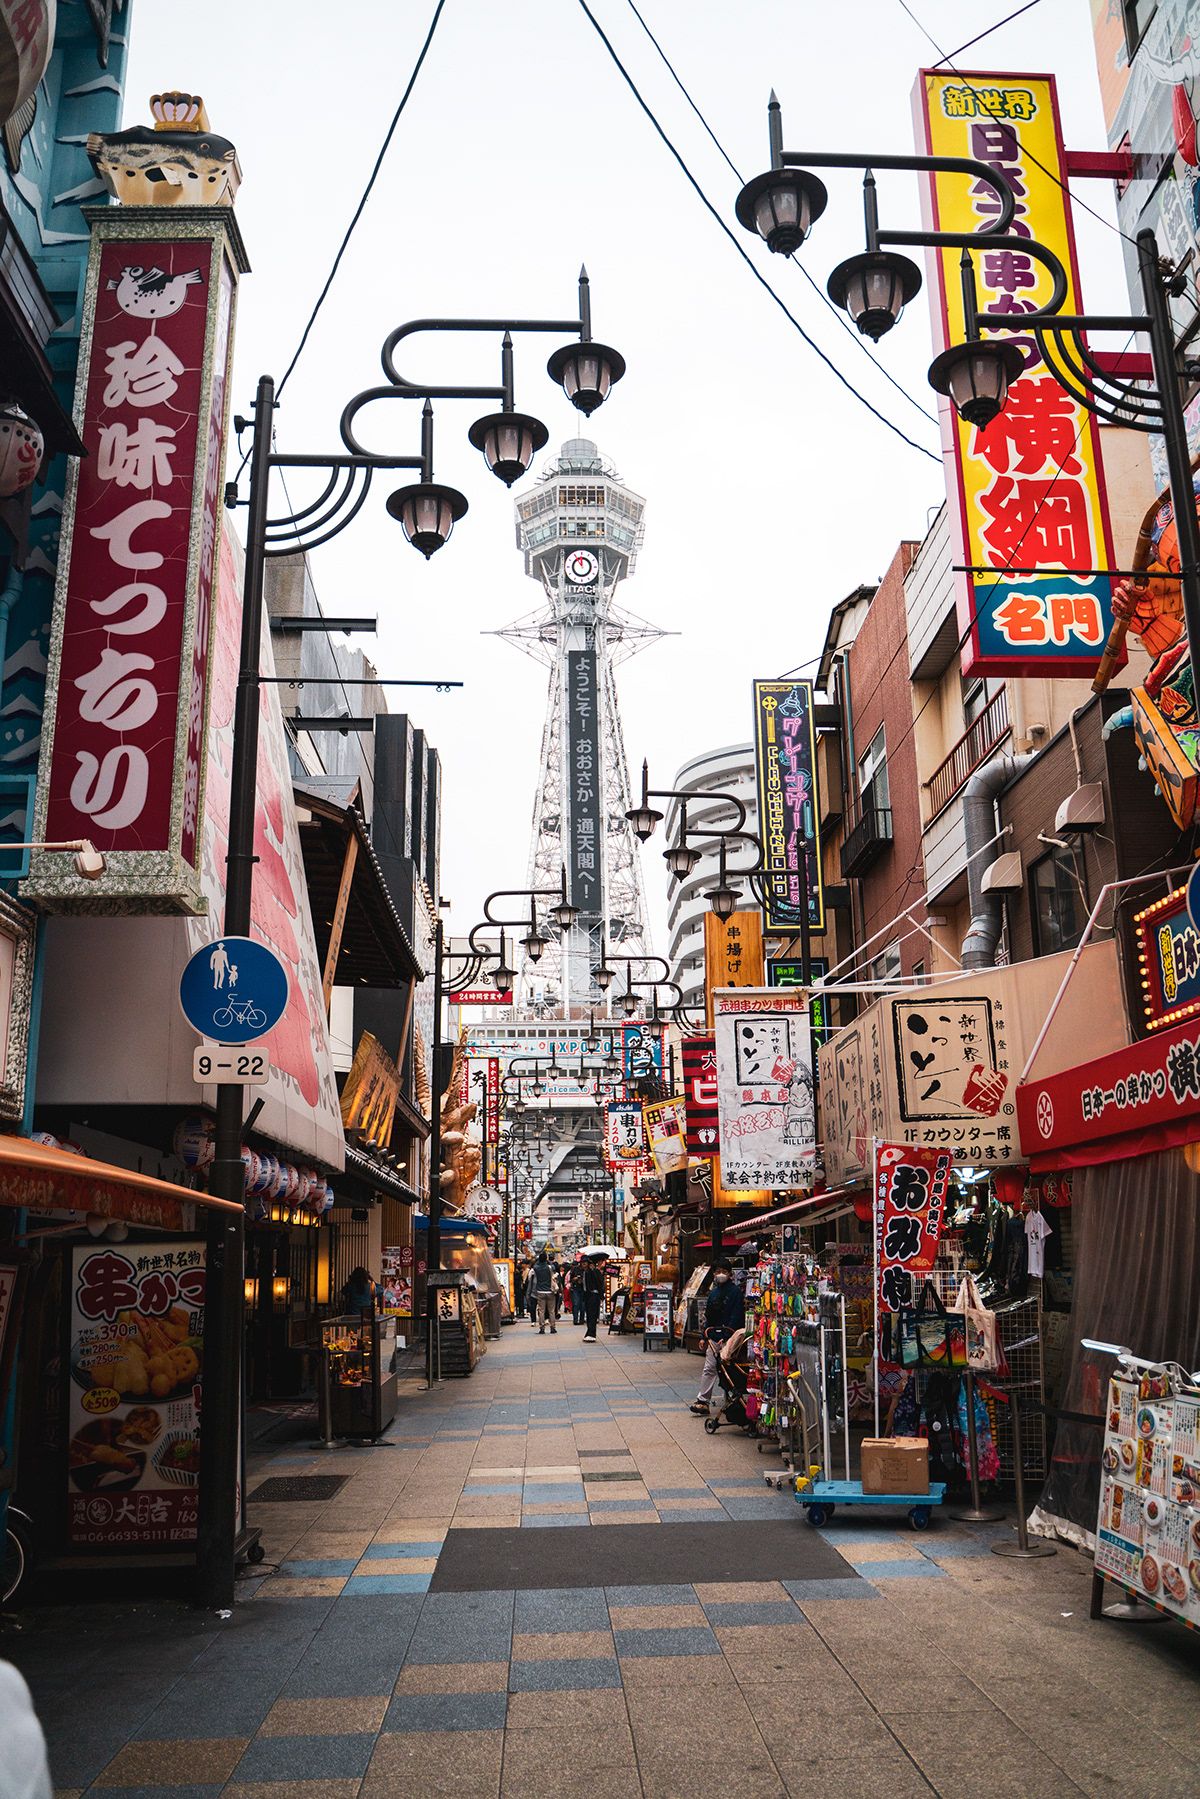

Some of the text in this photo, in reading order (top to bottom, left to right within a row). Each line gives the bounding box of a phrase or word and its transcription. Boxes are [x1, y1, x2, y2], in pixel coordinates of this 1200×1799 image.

[944, 87, 1035, 120] 新世界
[973, 377, 1096, 580] 横綱
[70, 335, 185, 830] 珍味てっちり
[998, 597, 1100, 642] 名門
[768, 746, 780, 791] CLAW
[769, 791, 785, 855] MACHINE
[726, 926, 743, 973] 串揚げ
[1160, 927, 1176, 1000] 新世界
[1174, 930, 1200, 984] 日本
[719, 999, 805, 1012] 元祖串カツ専門店
[958, 1013, 983, 1063] 新世界
[199, 1056, 264, 1076] 9-22
[1082, 1072, 1166, 1120] 日本一の串かつ
[620, 1113, 637, 1148] 串カツ
[726, 1170, 813, 1185] 宴会予約受付中
[137, 1250, 201, 1272] 新世界名物
[78, 1251, 207, 1322] 串かつ
